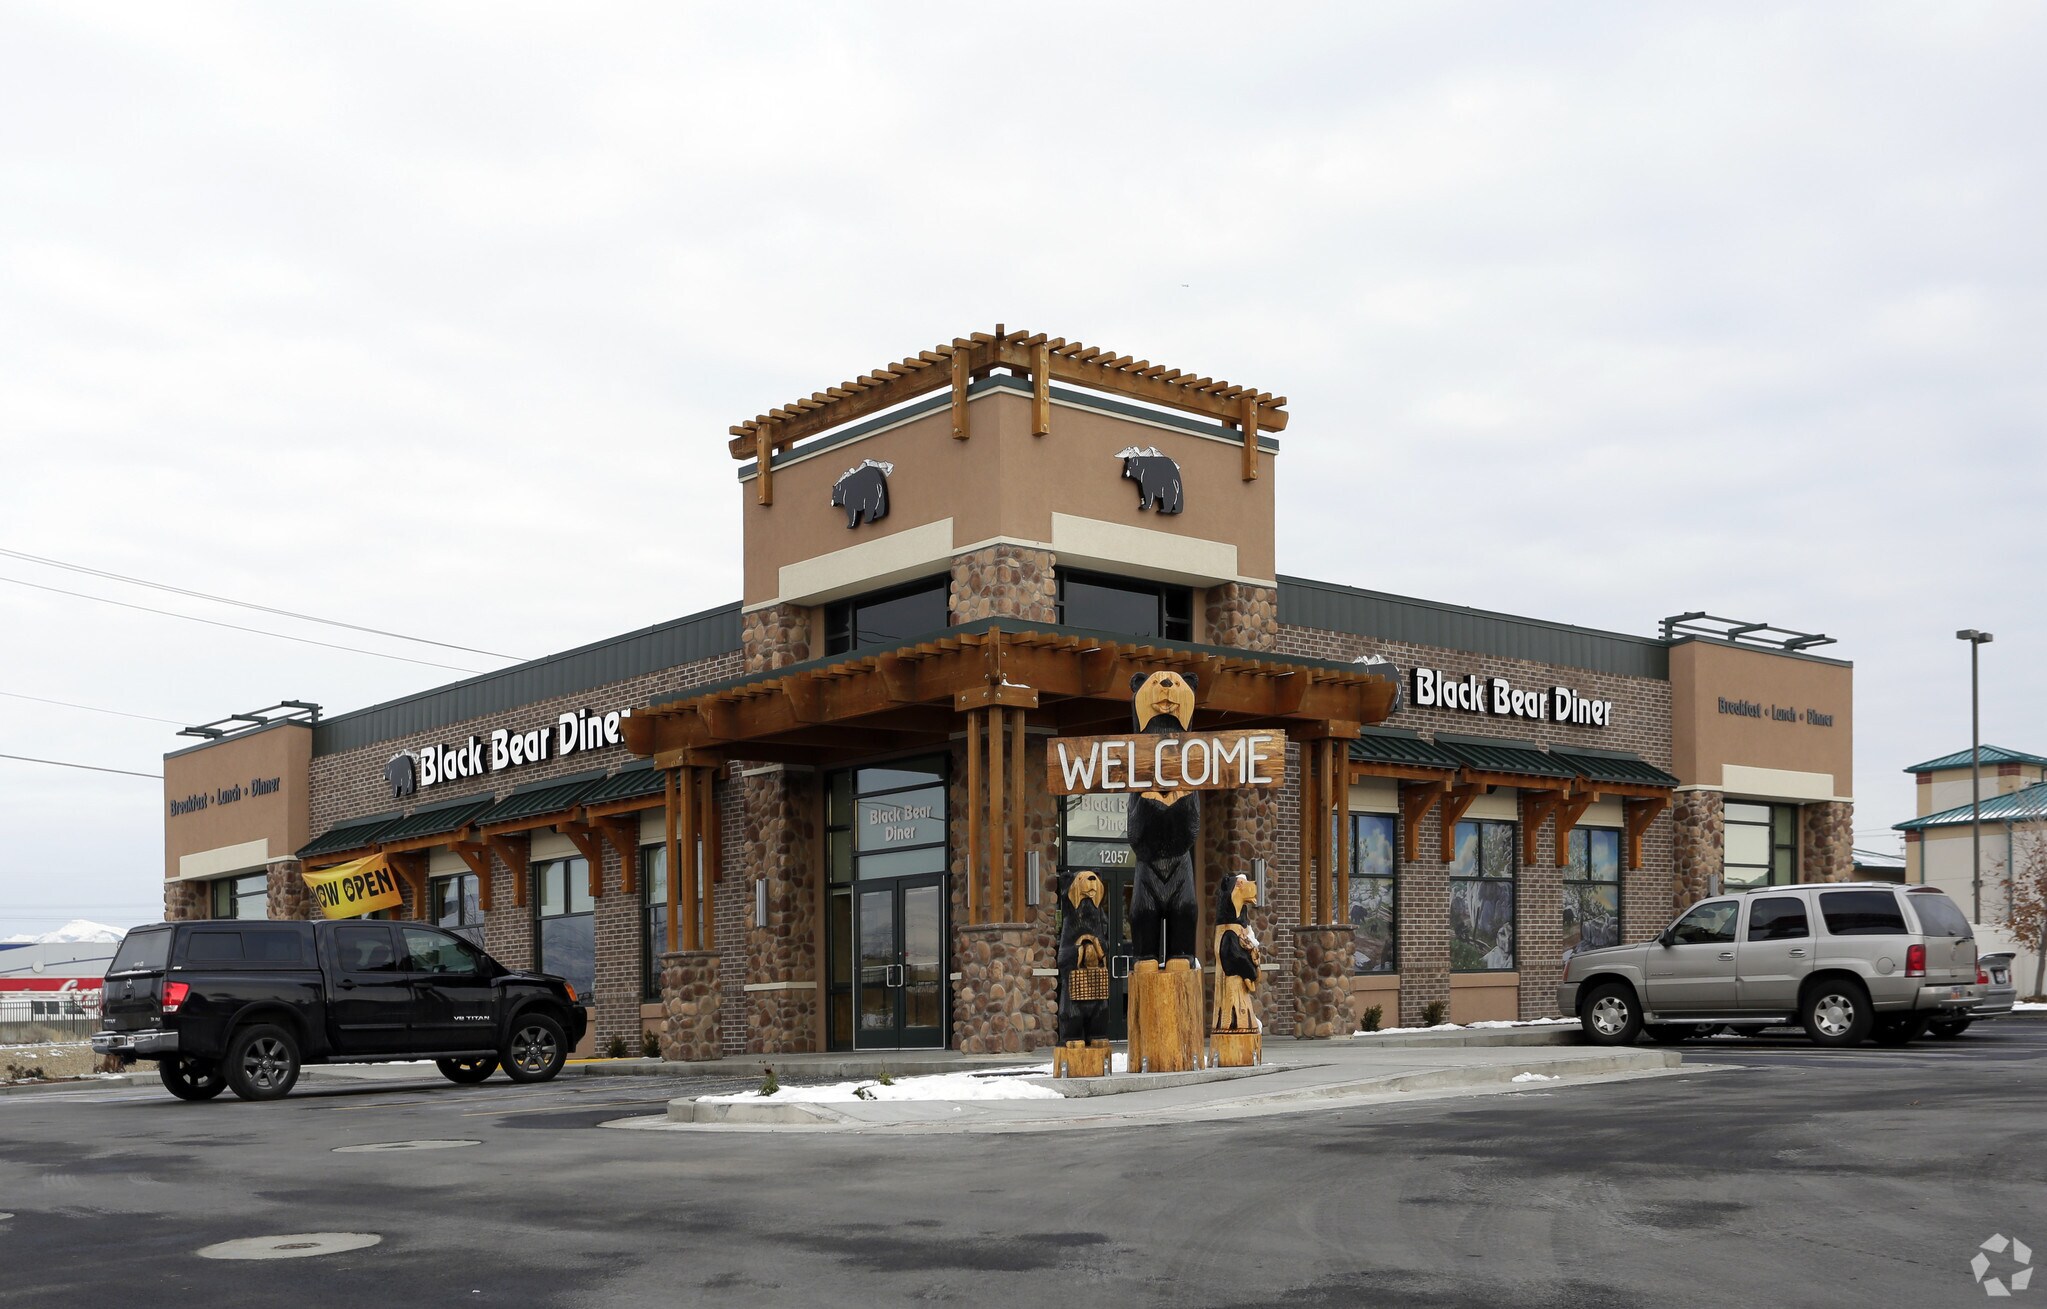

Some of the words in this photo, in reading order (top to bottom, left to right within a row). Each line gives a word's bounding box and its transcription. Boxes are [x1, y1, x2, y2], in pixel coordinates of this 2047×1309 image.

[1415, 667, 1485, 712] Black
[1492, 678, 1548, 719] Bear
[1554, 686, 1612, 726] Diner
[1718, 697, 1761, 718] Breakfast
[1772, 704, 1796, 722] Lunch
[1806, 708, 1833, 727] Dinner
[420, 736, 484, 786] Black
[491, 727, 550, 771] Bear
[1057, 735, 1273, 791] WELCOME
[170, 793, 208, 817] Breakfast
[217, 784, 241, 805] Lunch
[251, 777, 280, 797] Dinner
[1080, 796, 1114, 812] Black
[870, 807, 902, 825] Black
[904, 804, 932, 821] Bear
[1096, 815, 1127, 831] Dine
[885, 826, 916, 842] Diner
[1099, 849, 1129, 864] 12057
[342, 867, 395, 902] OPEN
